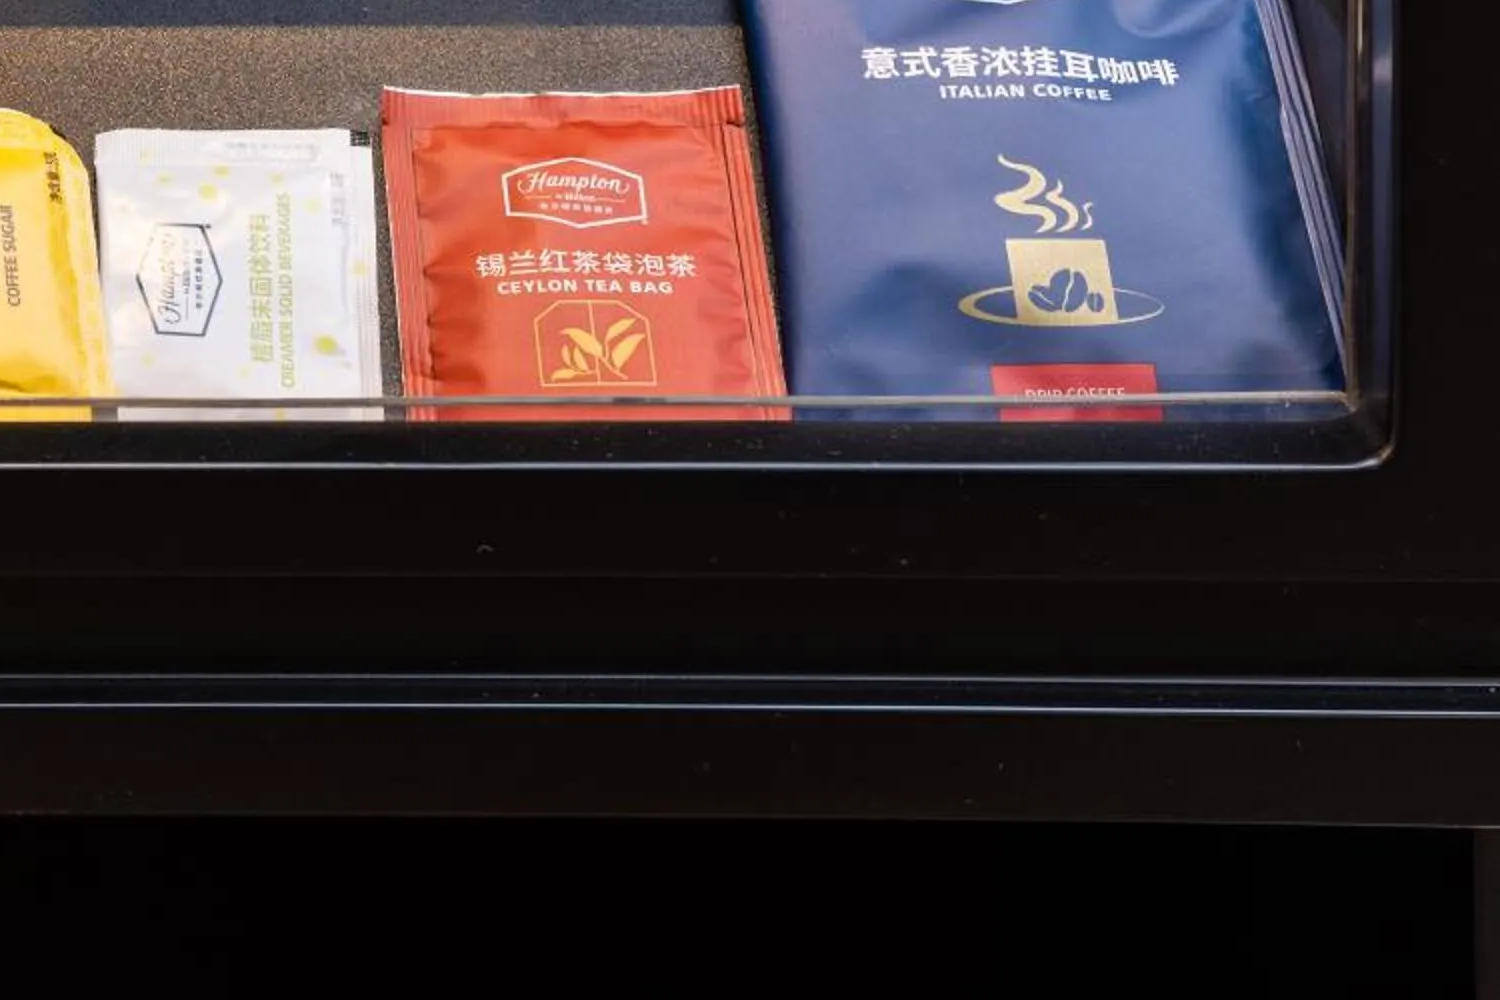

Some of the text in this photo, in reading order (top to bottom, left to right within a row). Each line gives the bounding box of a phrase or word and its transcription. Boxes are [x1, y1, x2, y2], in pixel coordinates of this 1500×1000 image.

[861, 46, 1180, 86] 意式香浓挂耳咖啡
[939, 83, 1113, 101] ITALIAN COFFEE
[517, 171, 631, 194] Hampton
[0, 204, 21, 307] COFFEE SUGAR
[476, 249, 698, 277] 锡兰红茶袋泡茶
[277, 275, 294, 317] SOLID
[498, 279, 674, 295] CEYLON TEA BAG
